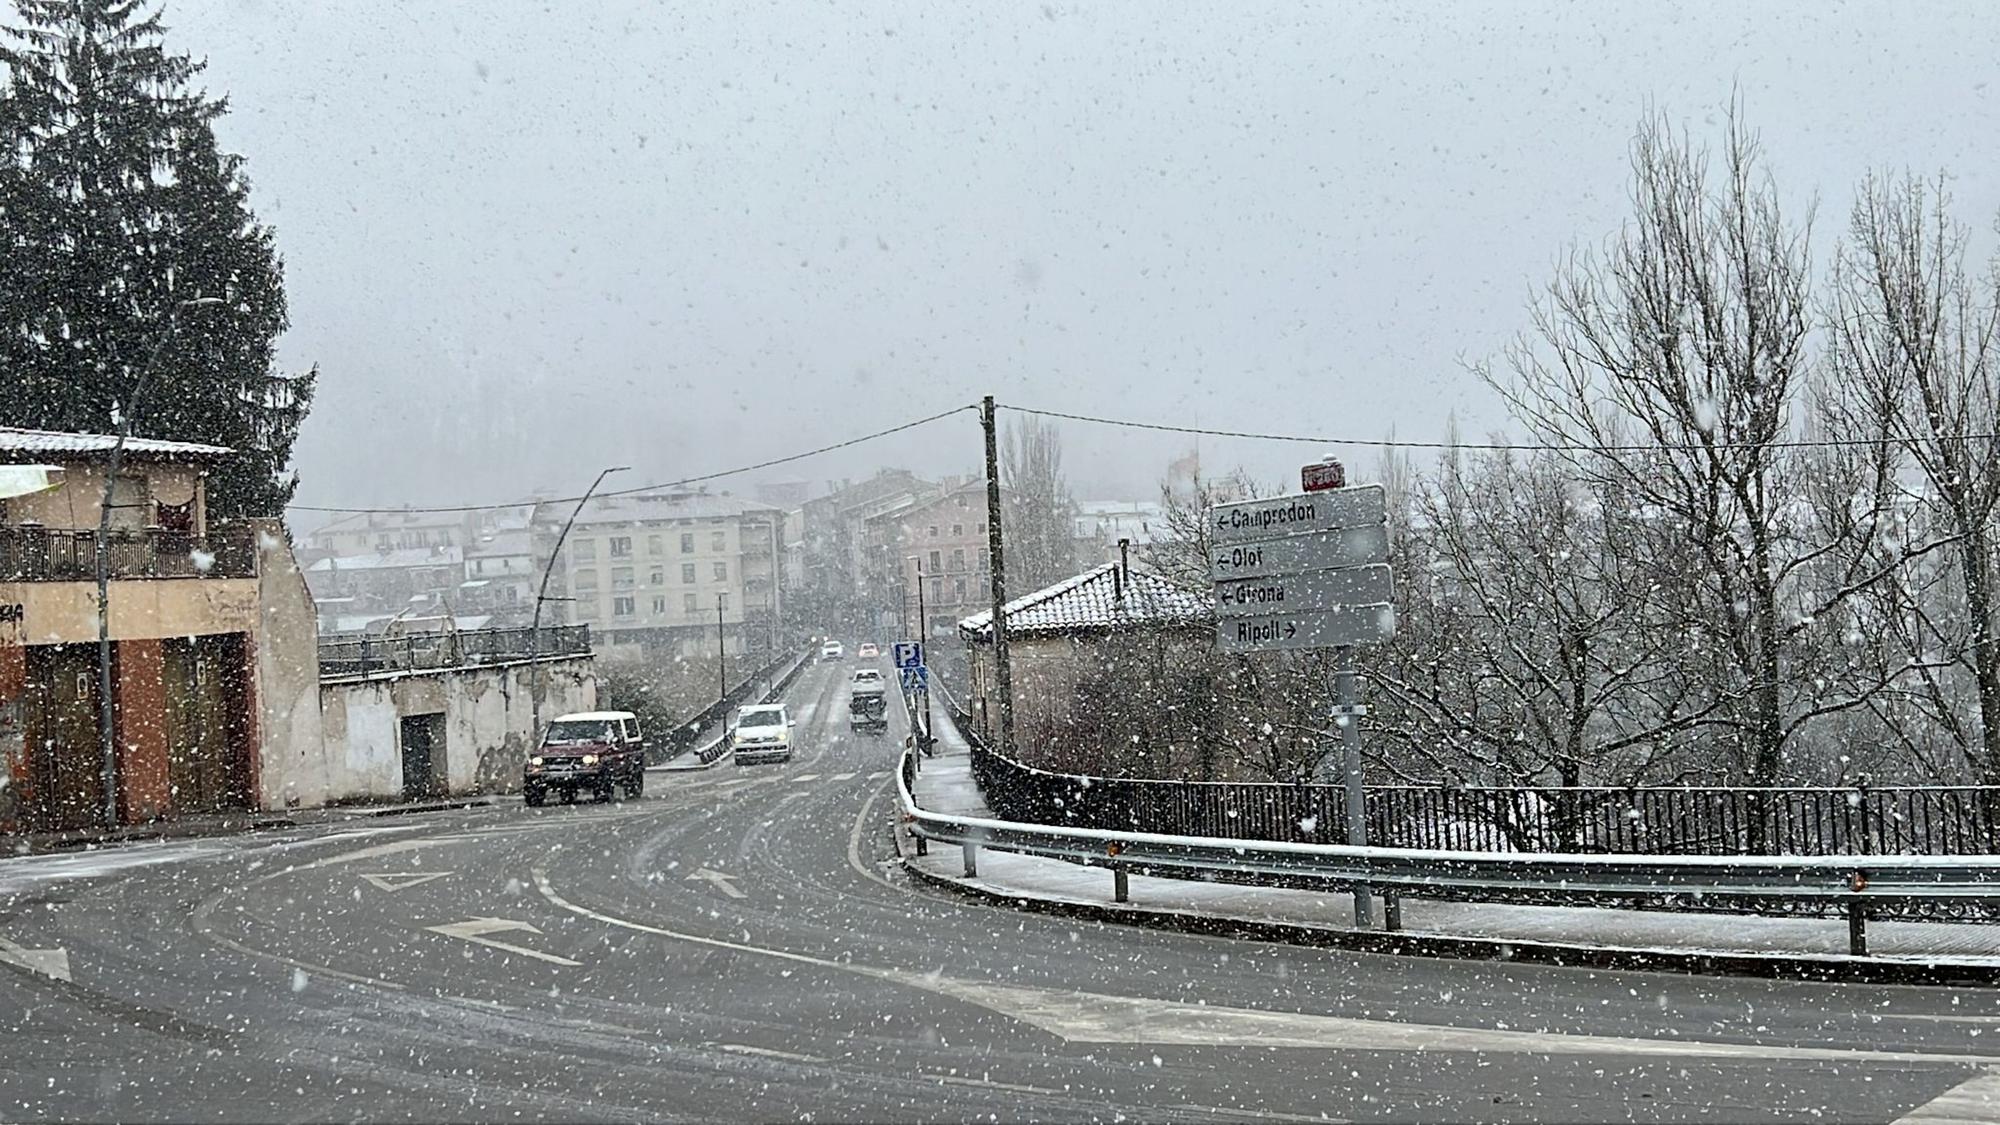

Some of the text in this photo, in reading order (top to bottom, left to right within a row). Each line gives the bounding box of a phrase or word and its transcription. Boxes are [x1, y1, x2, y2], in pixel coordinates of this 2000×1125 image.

[1233, 547, 1262, 567] Olot
[1236, 584, 1284, 604] Girona
[1238, 620, 1280, 645] Ripoll
